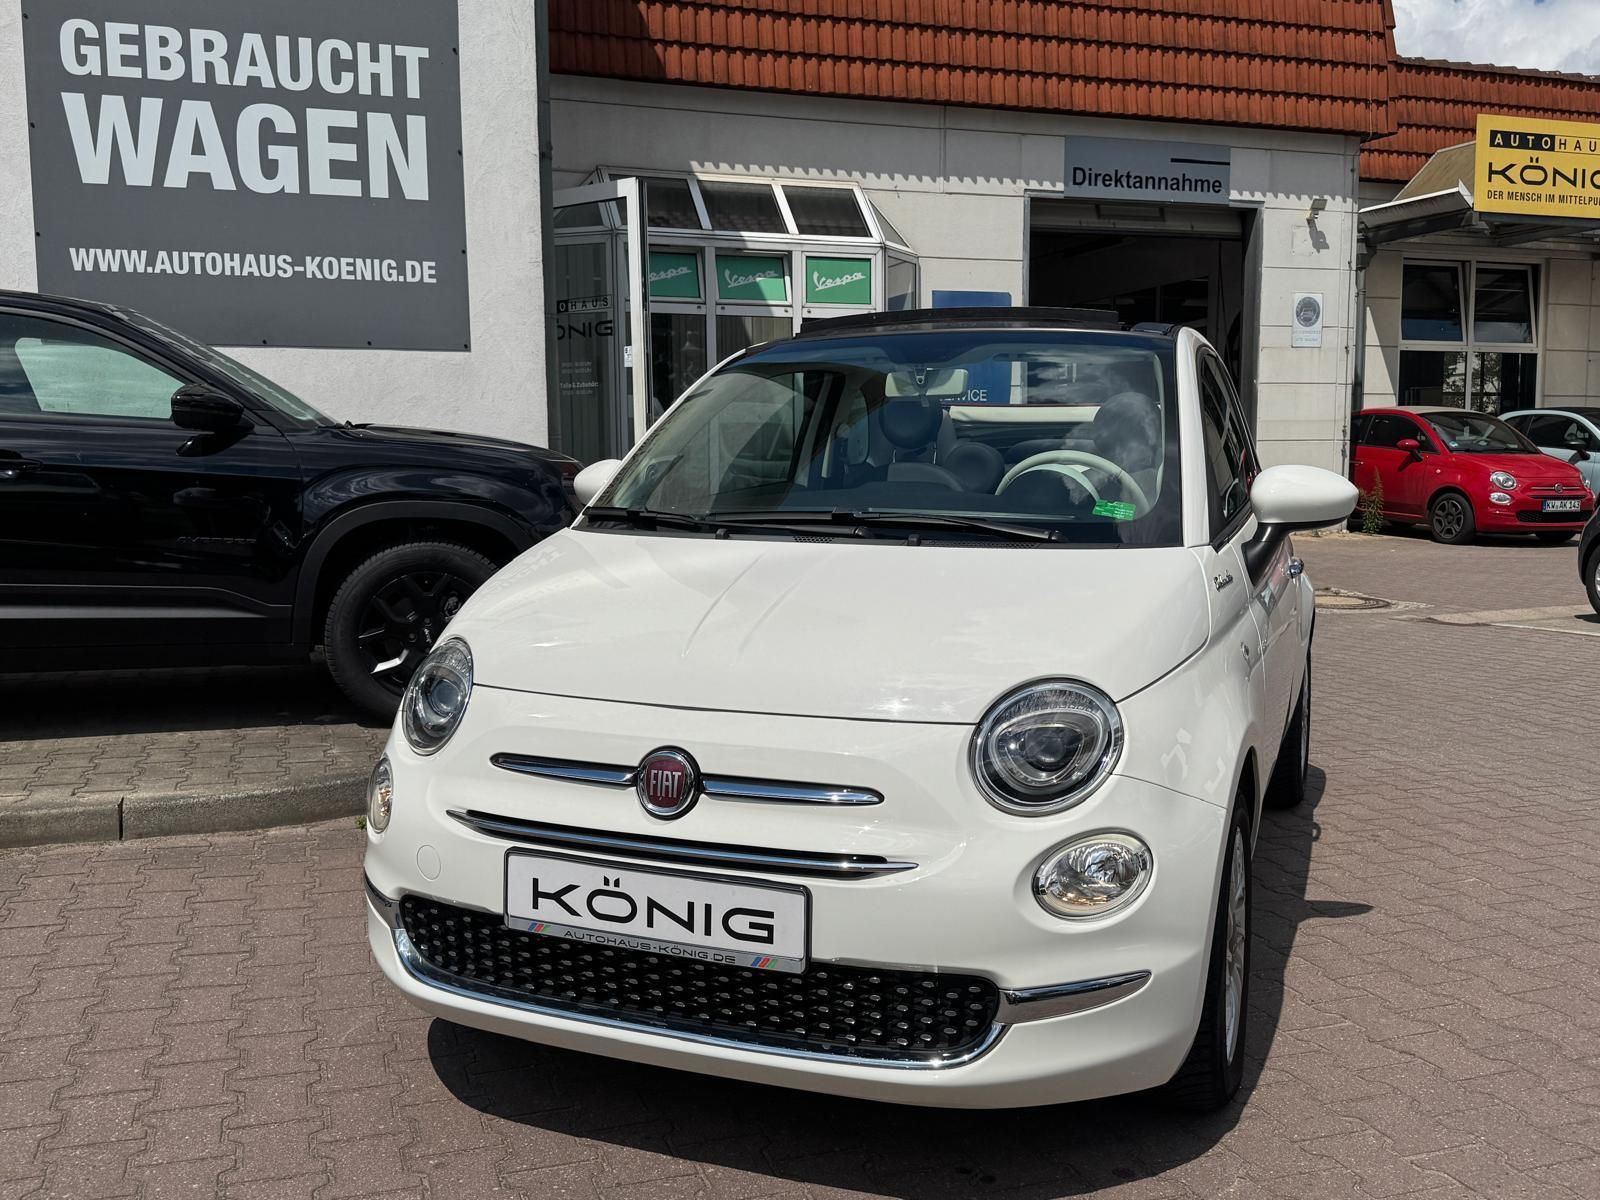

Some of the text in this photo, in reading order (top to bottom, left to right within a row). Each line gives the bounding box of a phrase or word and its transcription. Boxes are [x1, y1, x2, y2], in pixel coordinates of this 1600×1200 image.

[60, 18, 429, 99] GEBRAUCHT
[61, 92, 429, 201] WAGEN
[1494, 133, 1597, 152] AUTOHAU
[1072, 166, 1222, 193] Direktannahme
[1487, 190, 1600, 206] DER MENSCH IM MITTELPU
[69, 247, 437, 283] WWW.AUTOHAUS-KOENIG.DE
[649, 266, 693, 282] espa
[724, 268, 780, 288] Vespa
[812, 271, 867, 291] Vespa
[559, 296, 609, 312] OHAUS
[650, 769, 682, 798] FIAT
[531, 875, 775, 945] KÖNIG
[563, 930, 737, 965] AUTOHAUS-KÖNIG.DE
